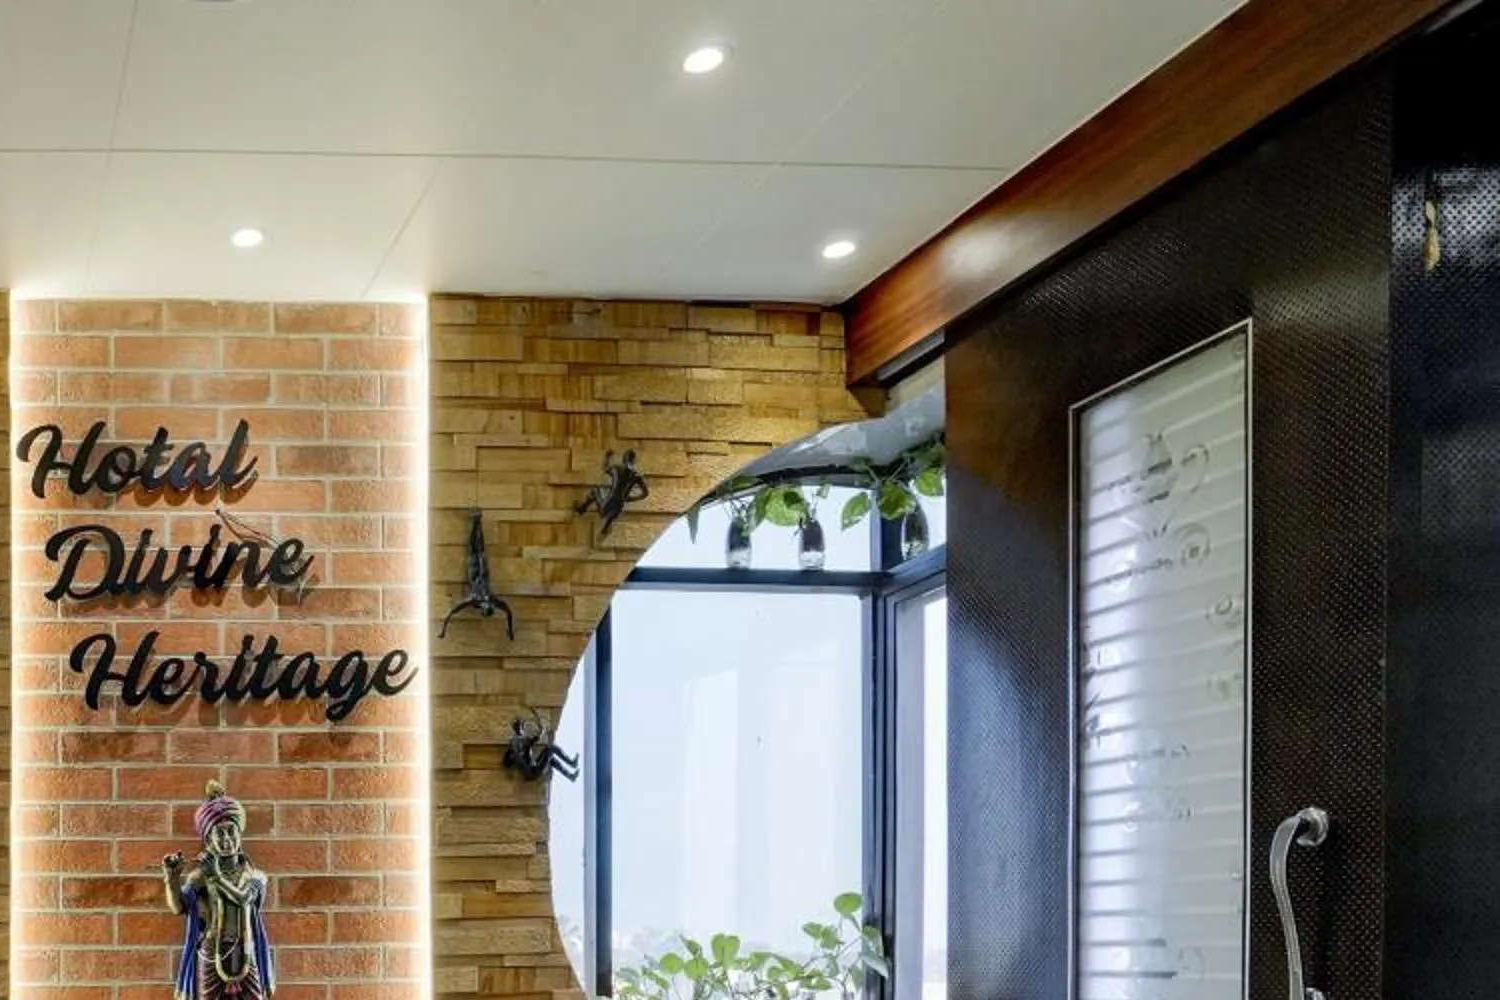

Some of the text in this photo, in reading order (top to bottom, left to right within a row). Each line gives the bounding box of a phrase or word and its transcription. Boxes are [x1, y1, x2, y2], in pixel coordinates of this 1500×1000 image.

[16, 418, 259, 498] Hotal
[44, 524, 315, 601] Divine
[69, 631, 418, 721] Heritage
